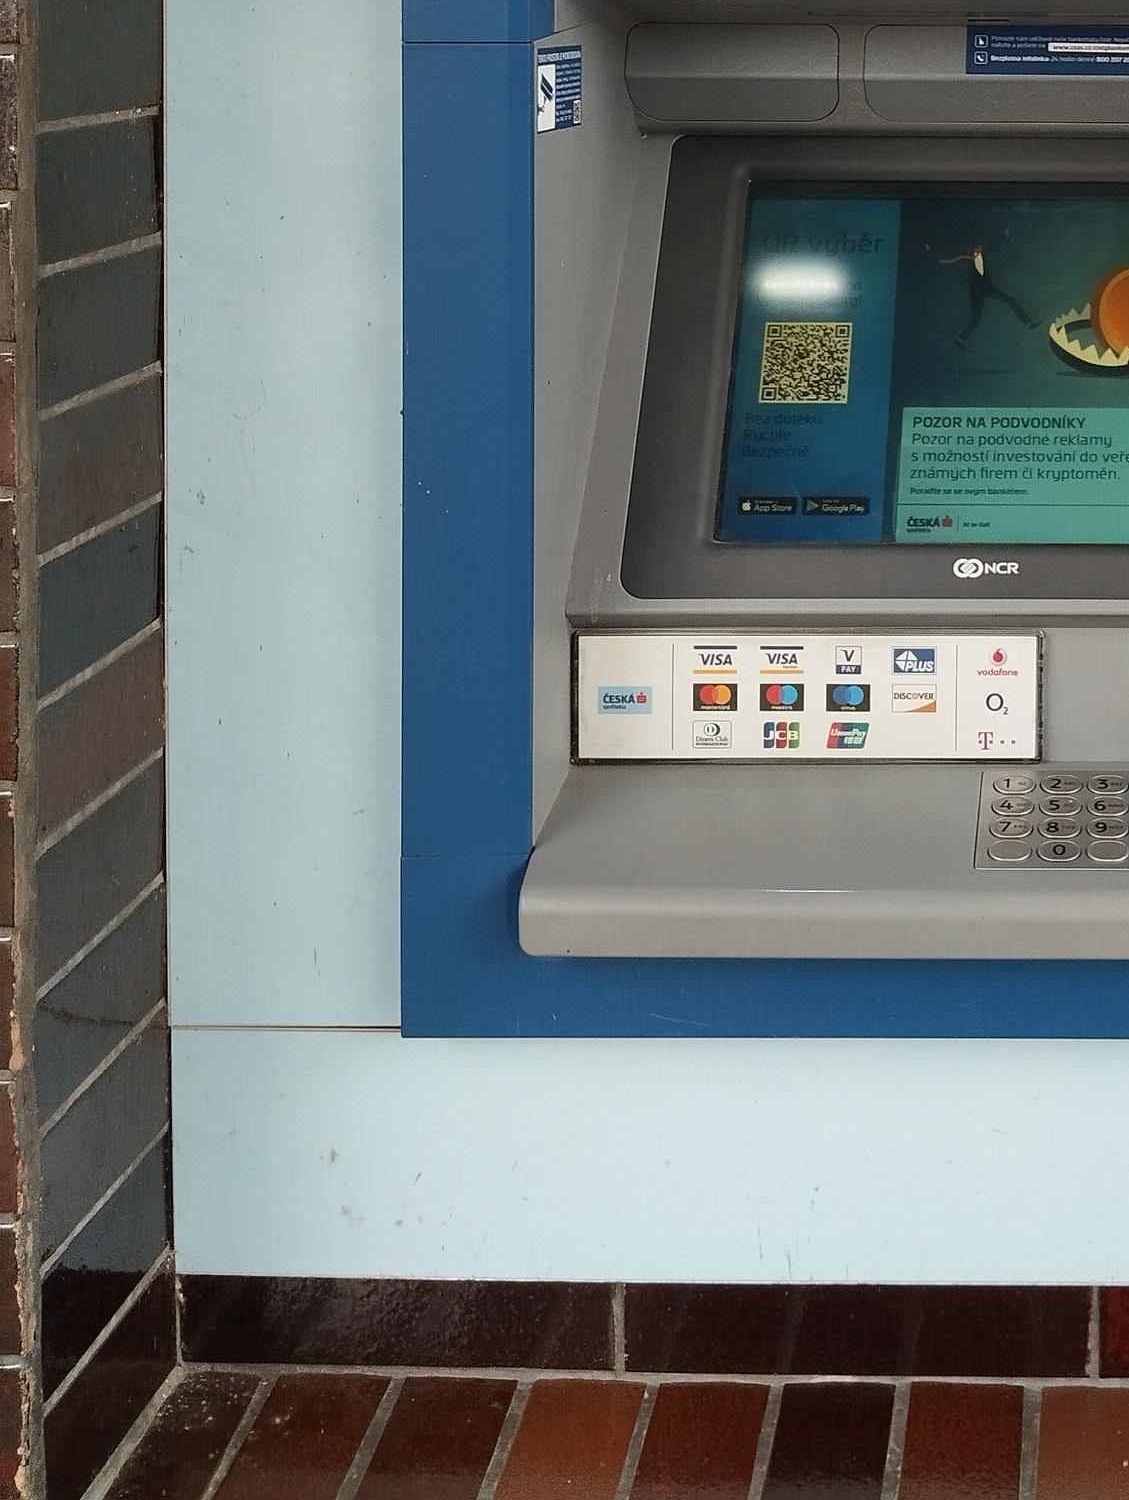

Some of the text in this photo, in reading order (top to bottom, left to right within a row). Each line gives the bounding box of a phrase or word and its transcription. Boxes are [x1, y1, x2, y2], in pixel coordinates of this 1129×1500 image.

[912, 414, 1086, 429] POZOR NA PODVODNÍKY
[911, 433, 1112, 448] Pozor na podvodné reklamy
[911, 452, 919, 462] s
[923, 450, 989, 462] možností
[993, 450, 1076, 463] investování
[1080, 451, 1098, 463] do
[909, 467, 1120, 482] známých firem či kryptoměn.
[754, 504, 793, 512] App Store
[821, 504, 848, 513] Google
[907, 516, 940, 528] ČESKÁ
[984, 562, 1020, 575] NCR
[698, 653, 733, 666] VISA
[765, 653, 798, 665] VISA
[841, 649, 855, 662] V
[905, 660, 935, 673] PLUS
[976, 668, 1019, 677] vodafone
[602, 692, 636, 704] ČESKÁ
[893, 692, 935, 701] DISCOVER
[1003, 778, 1011, 789] 1
[1050, 778, 1062, 789] 2
[1097, 779, 1109, 790] 3
[1000, 800, 1014, 811] 4
[1049, 800, 1060, 811] 5
[1094, 800, 1106, 811] 6
[1000, 821, 1012, 832] 7
[1046, 821, 1059, 833] 8
[1095, 822, 1108, 833] 9
[1052, 844, 1067, 856] 0
